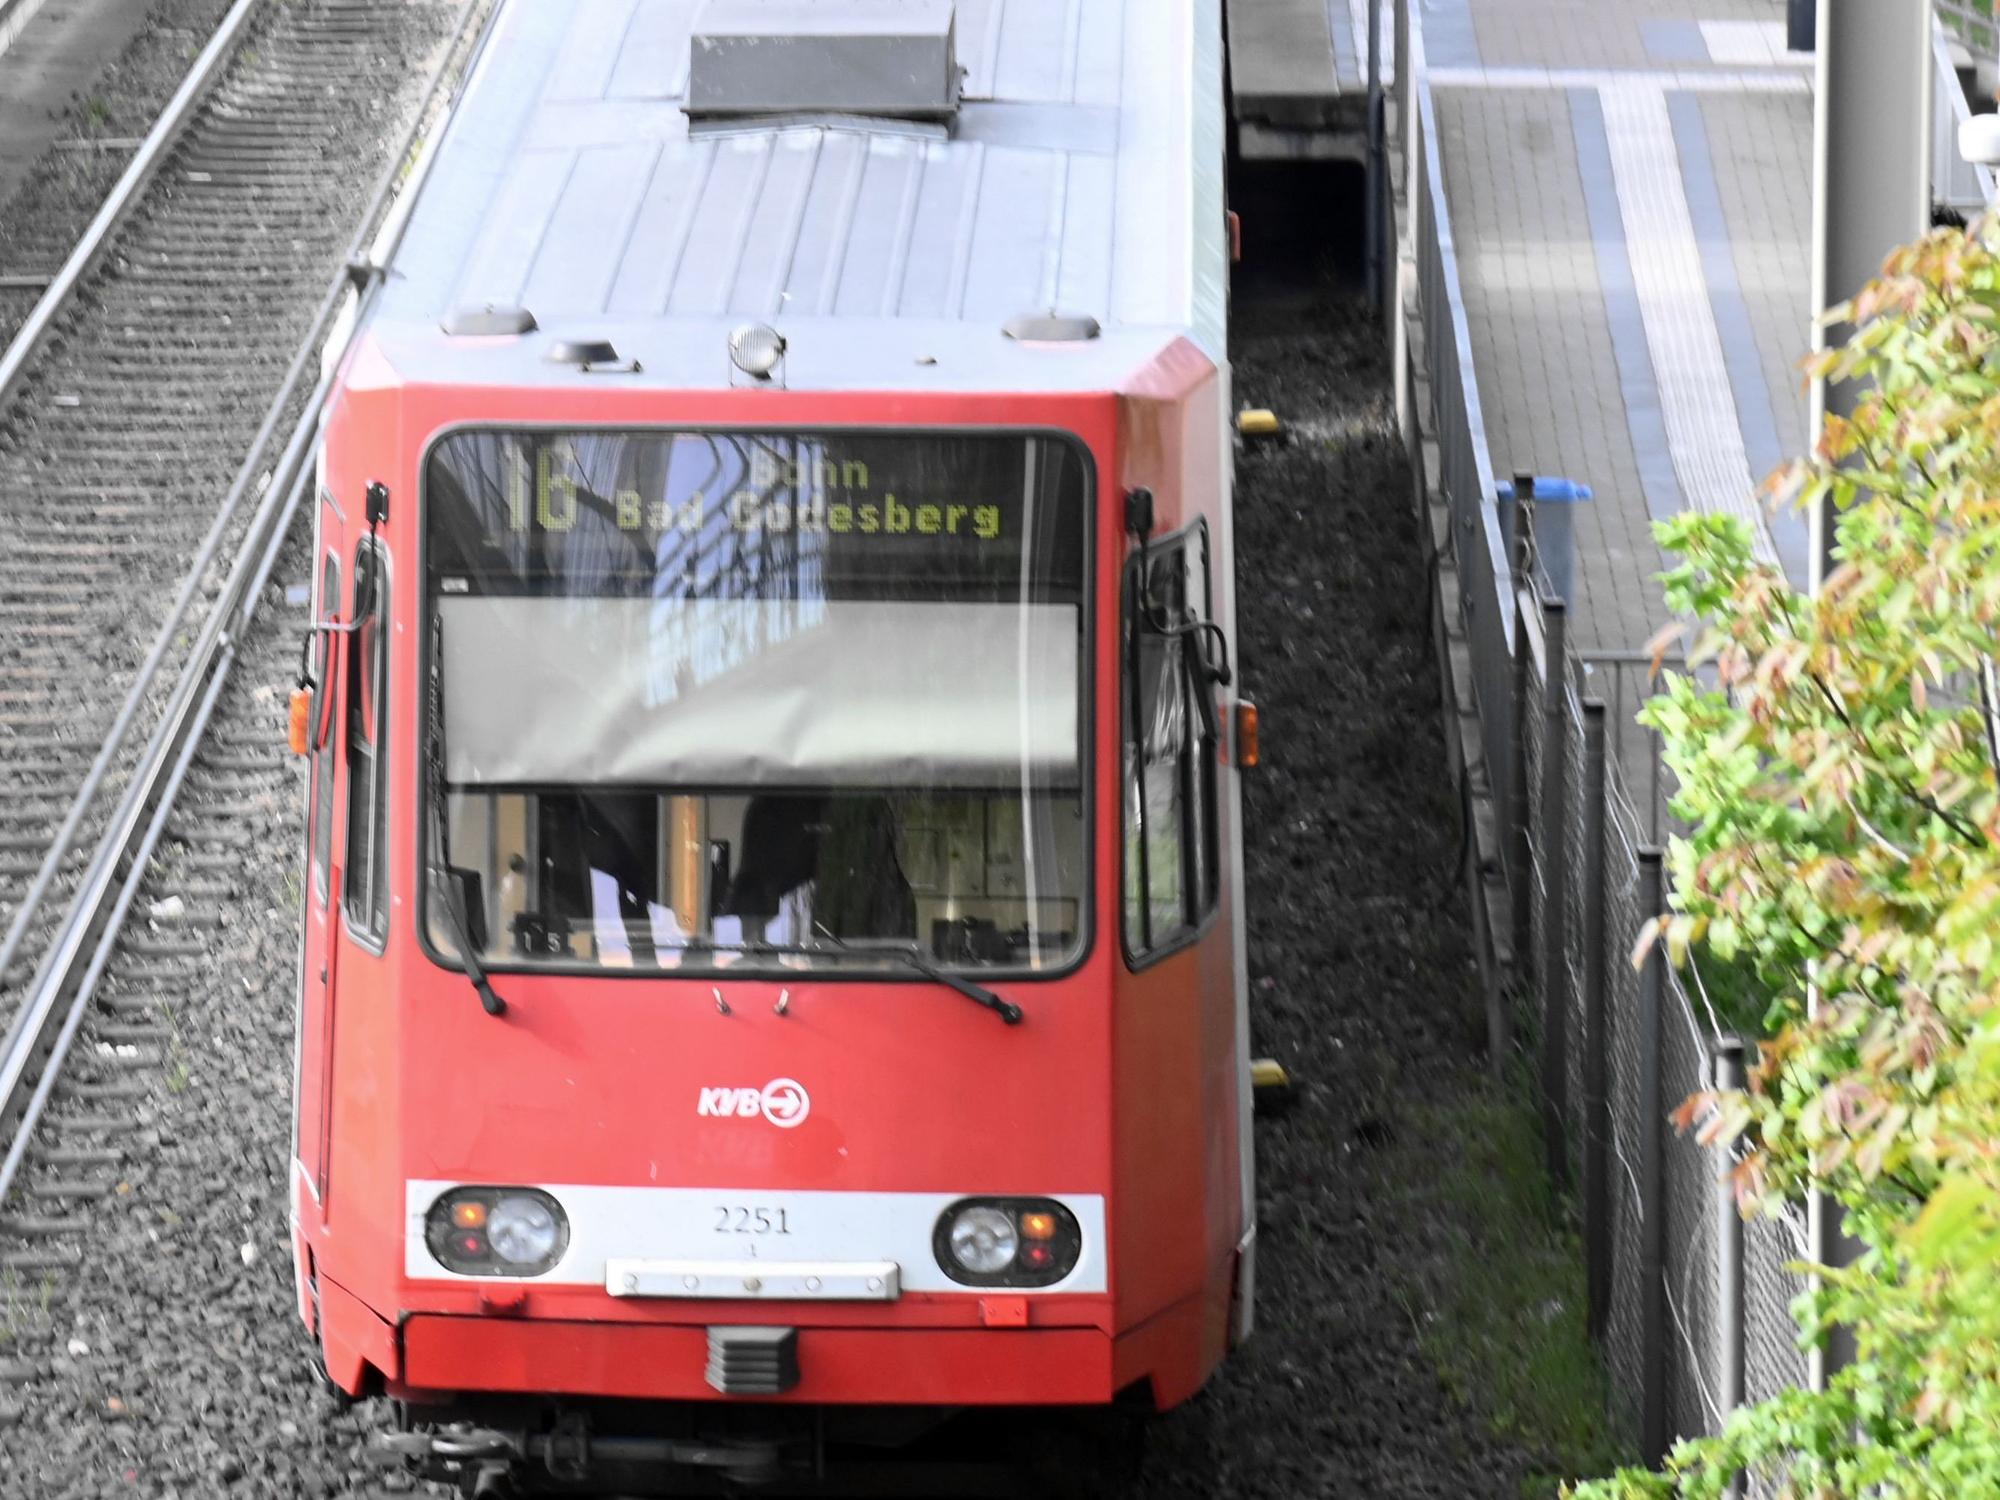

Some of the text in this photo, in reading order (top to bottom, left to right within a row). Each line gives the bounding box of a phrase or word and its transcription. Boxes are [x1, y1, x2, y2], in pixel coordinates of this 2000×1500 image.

[751, 458, 869, 490] Bonn
[616, 490, 999, 539] Bad Godesberg
[697, 1086, 762, 1118] KVB
[713, 1206, 791, 1235] 2251
